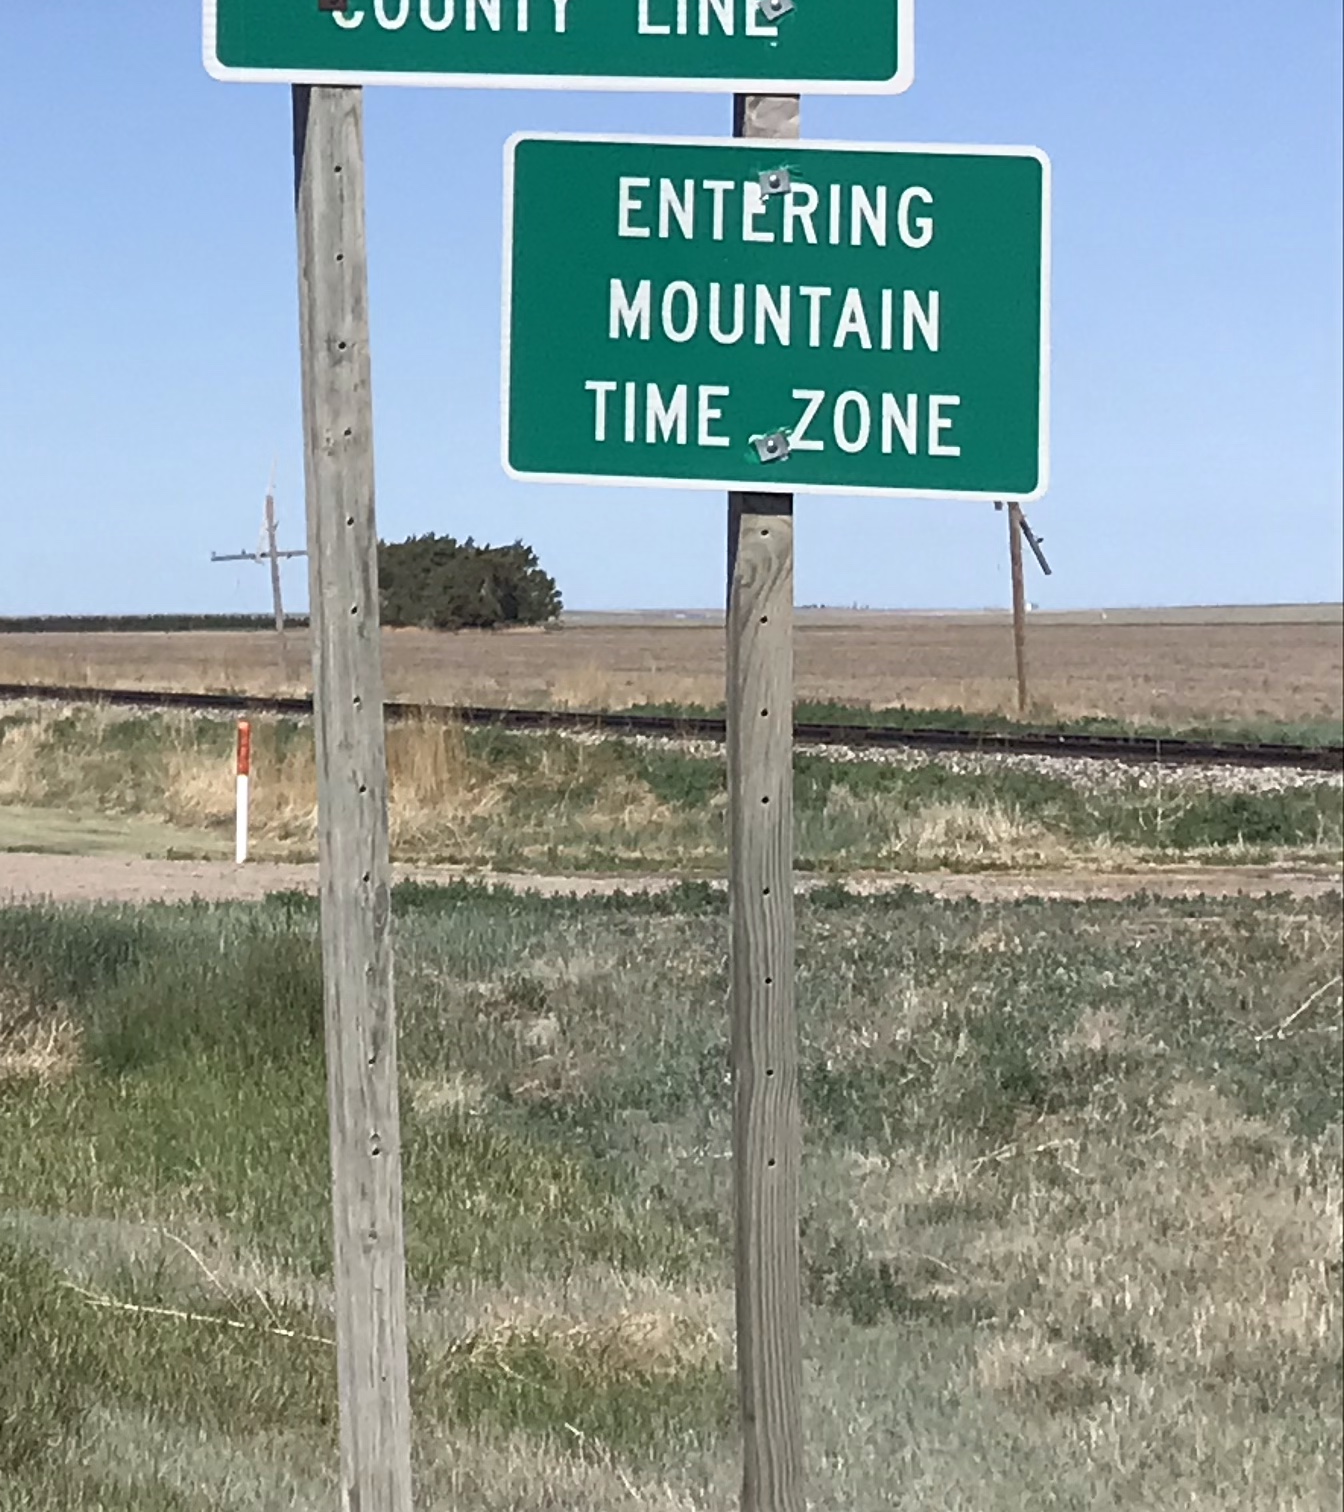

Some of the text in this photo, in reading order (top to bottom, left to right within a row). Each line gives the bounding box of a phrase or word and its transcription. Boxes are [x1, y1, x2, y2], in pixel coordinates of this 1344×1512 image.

[617, 176, 935, 249] ENTERING
[608, 278, 940, 352] MOUNTAIN
[584, 380, 961, 457] TIME ZONE
